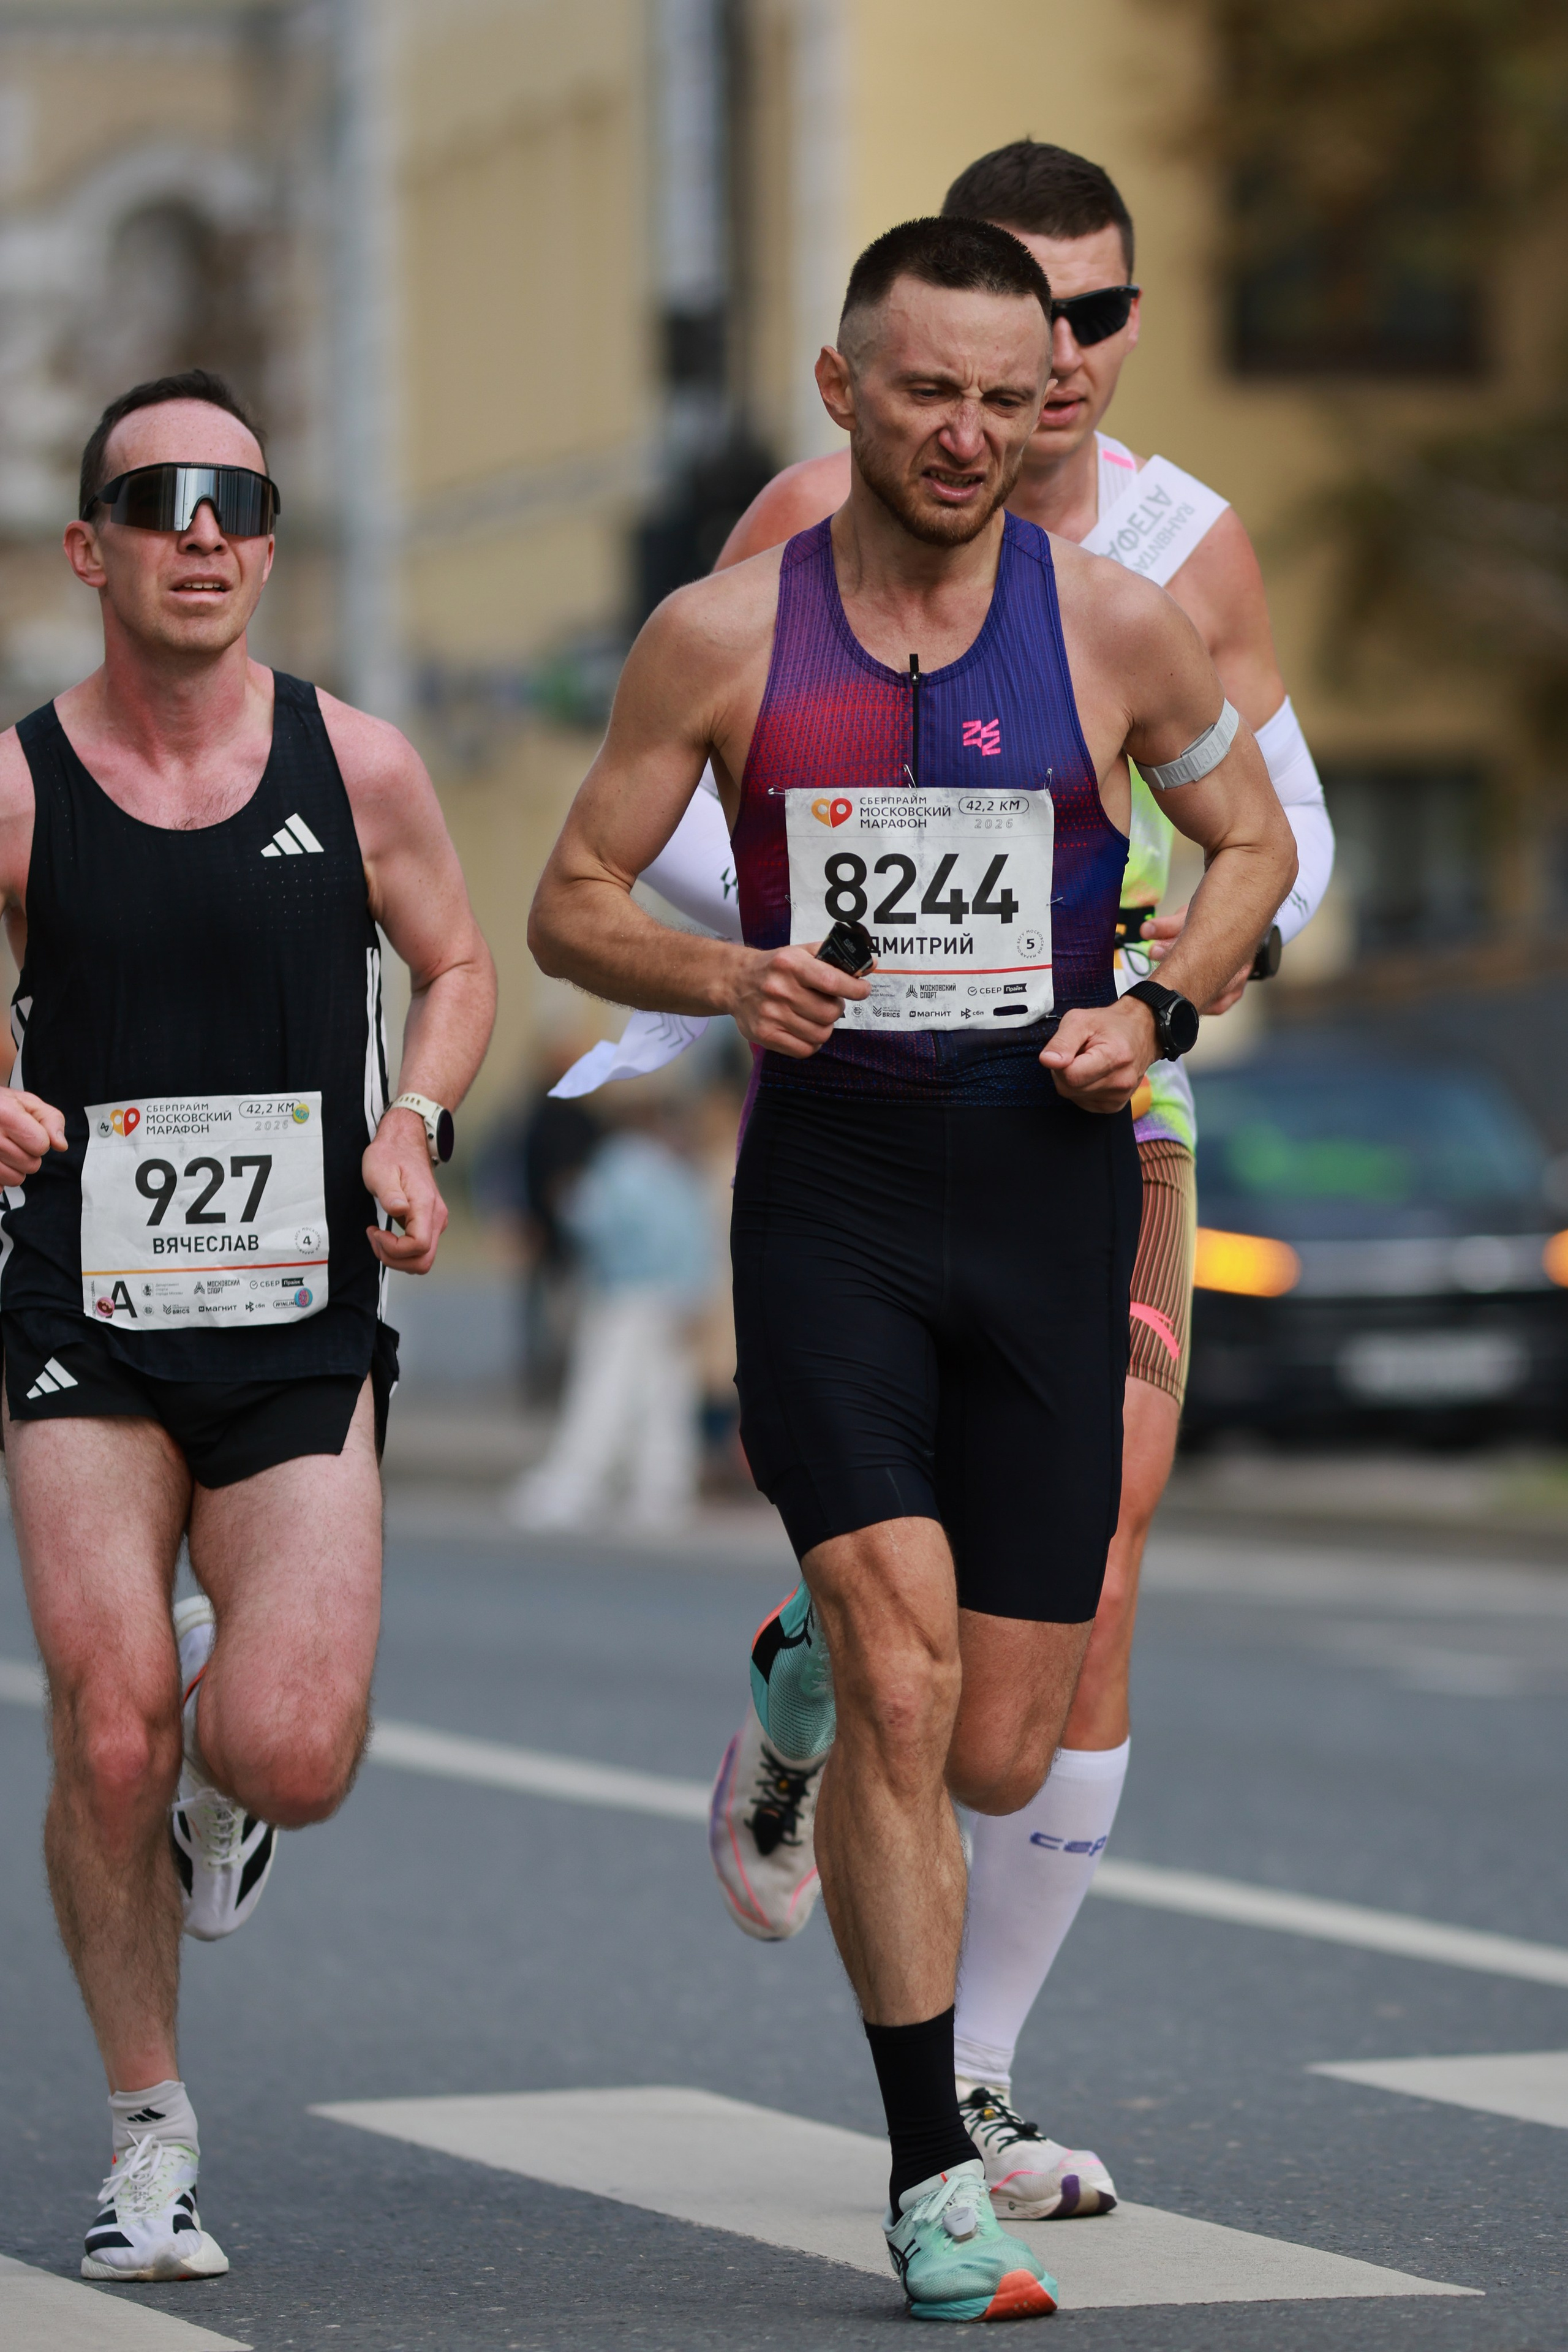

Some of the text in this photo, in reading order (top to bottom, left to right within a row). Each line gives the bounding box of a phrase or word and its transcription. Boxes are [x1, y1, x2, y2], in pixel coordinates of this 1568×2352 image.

[860, 796, 927, 805] СБЕРПРАЙМ
[966, 800, 995, 812] 42,2
[860, 804, 952, 817] МОСКОВСКИЙ
[860, 818, 928, 829] МАРАФОН
[974, 818, 1014, 829] 2026
[824, 852, 1019, 925] 8244
[1026, 938, 1035, 950] 5
[146, 1103, 209, 1113] СБЕРПРАЙМ
[246, 1104, 273, 1115] 42,2
[146, 1110, 232, 1124] МОСКОВСКИЙ
[146, 1124, 210, 1136] МАРАФОН
[254, 1120, 289, 1131] 2026
[135, 1155, 273, 1226] 927
[153, 1234, 259, 1254] ВЯЧЕСЛАВ
[303, 1235, 312, 1245] 4
[207, 1279, 240, 1287] МОСКОВСКИЙ
